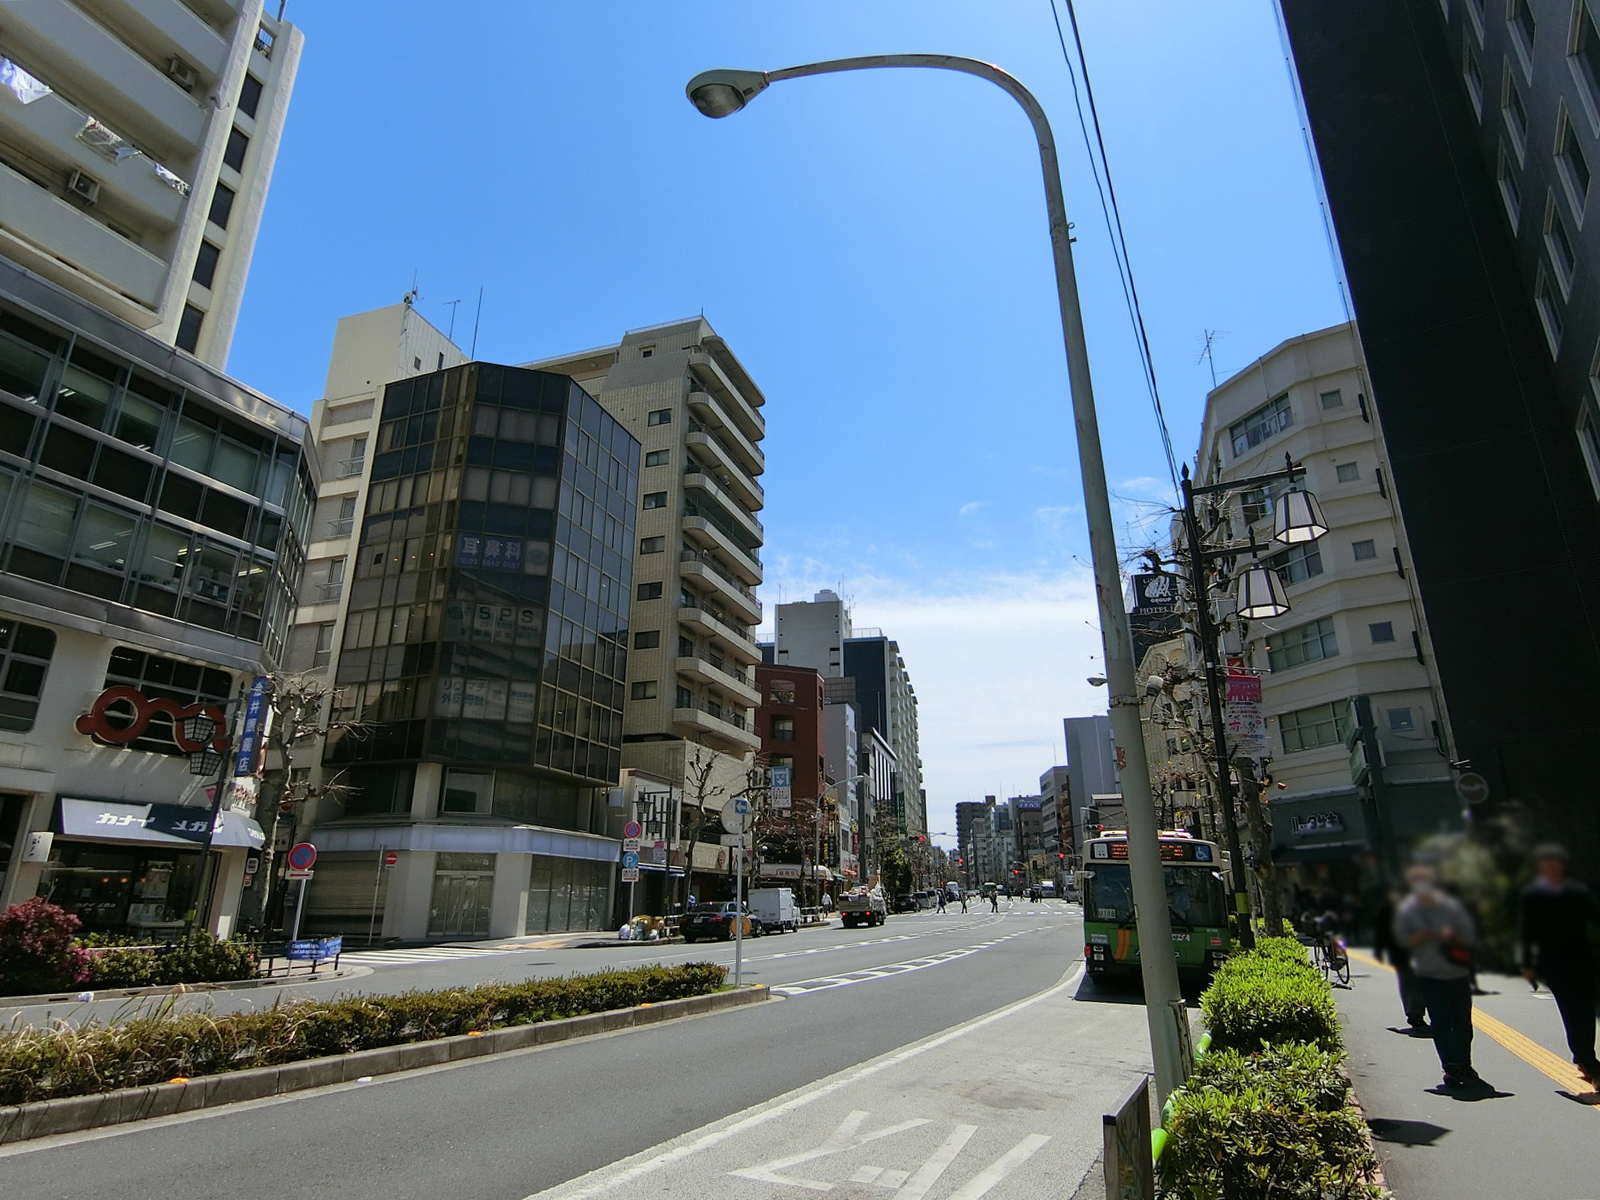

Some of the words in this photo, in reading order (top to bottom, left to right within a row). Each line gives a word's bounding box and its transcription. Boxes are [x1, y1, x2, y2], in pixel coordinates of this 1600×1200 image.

[461, 537, 521, 559] 耳鼻科
[1139, 606, 1170, 614] HOTEL
[237, 682, 263, 773] 金井眼鏡店
[95, 812, 156, 828] カナイ
